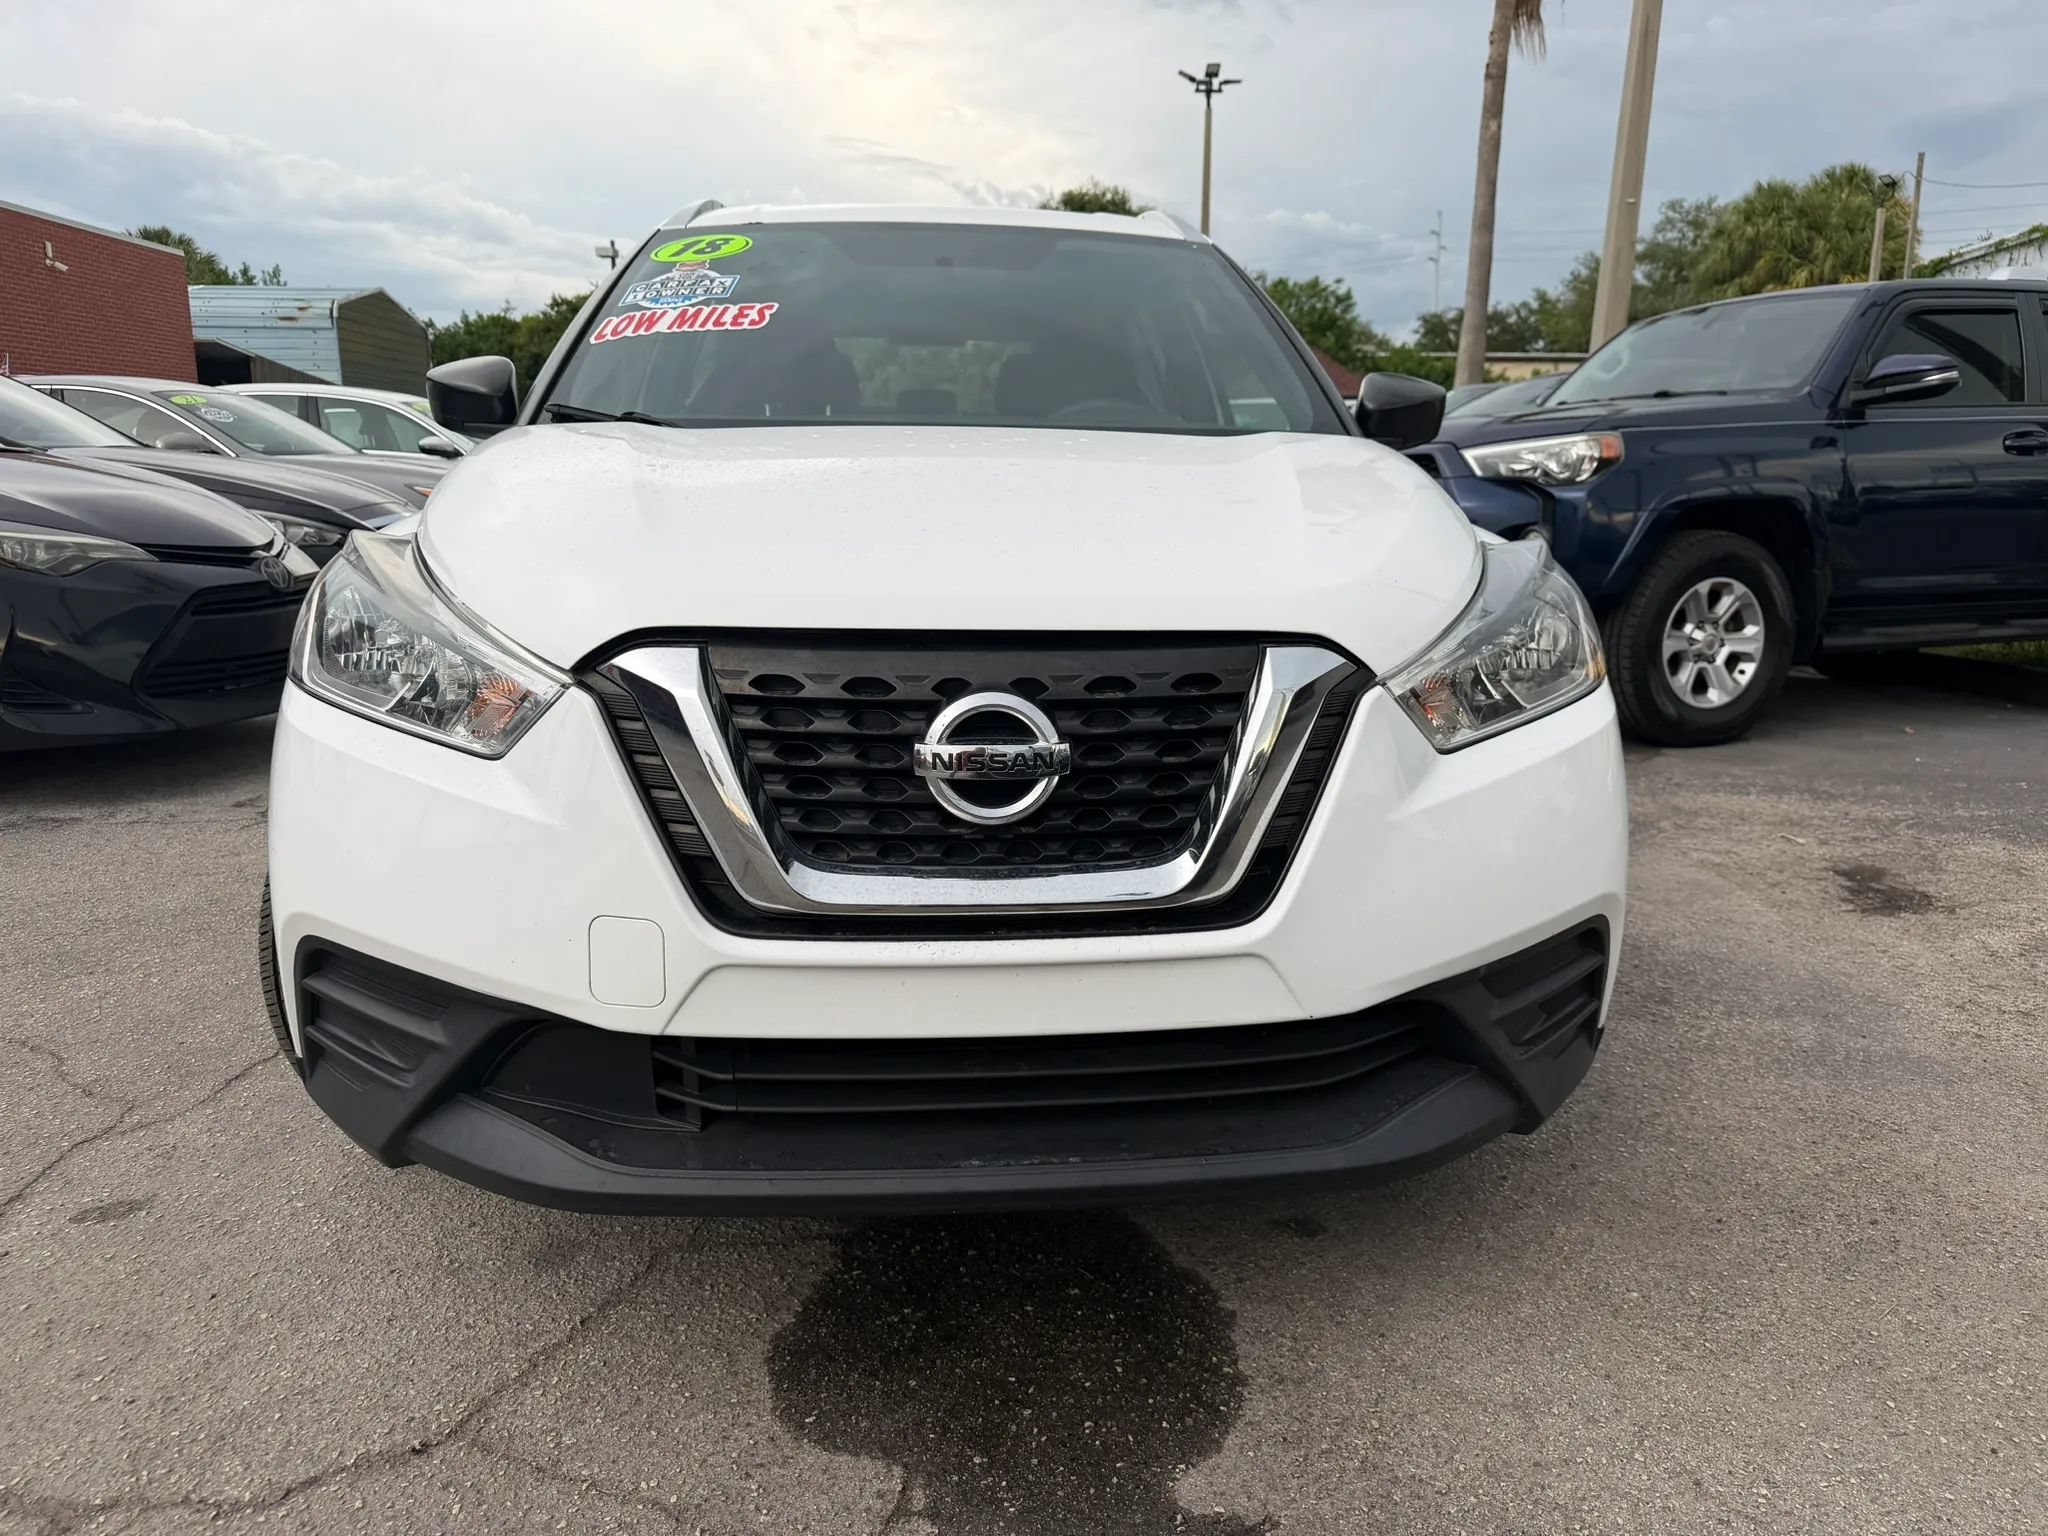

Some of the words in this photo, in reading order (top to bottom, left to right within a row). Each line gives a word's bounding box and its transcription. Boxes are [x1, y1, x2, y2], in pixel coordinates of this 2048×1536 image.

[667, 238, 735, 258] 18
[636, 279, 728, 292] CARFAX
[645, 287, 724, 298] OWNER
[593, 309, 668, 341] LOW
[667, 304, 776, 331] MILES
[931, 752, 1055, 773] NISSAN
